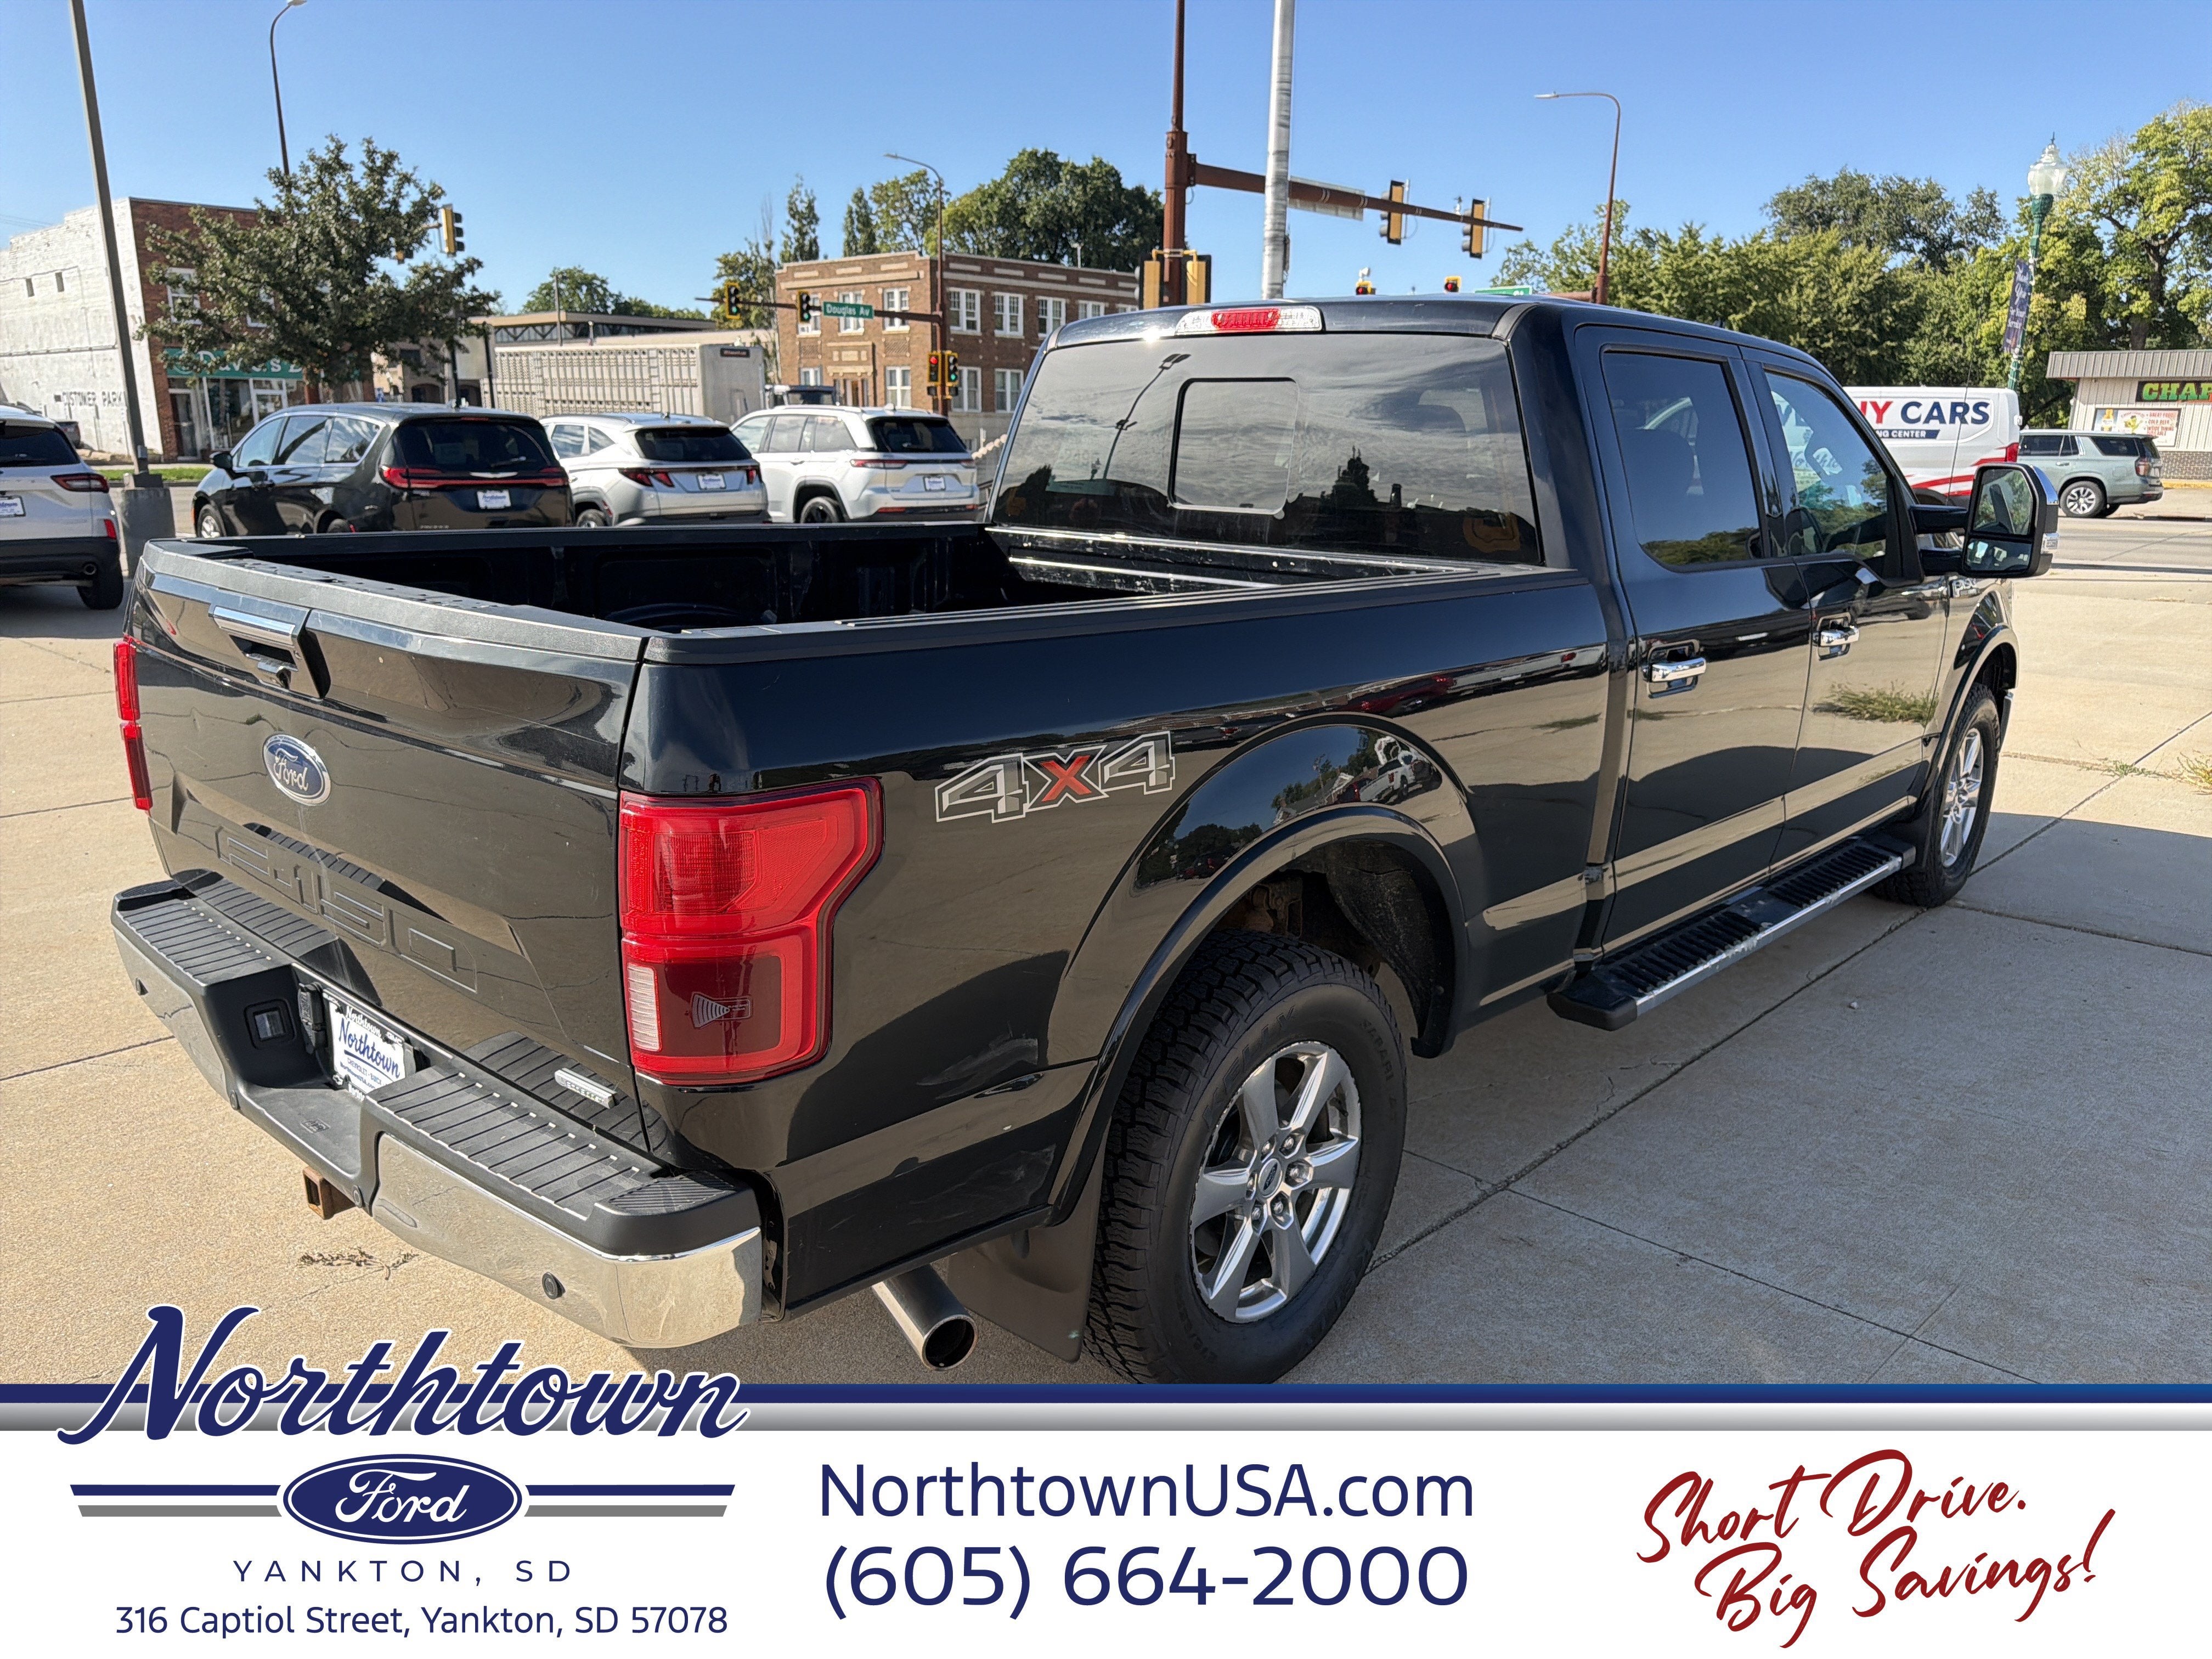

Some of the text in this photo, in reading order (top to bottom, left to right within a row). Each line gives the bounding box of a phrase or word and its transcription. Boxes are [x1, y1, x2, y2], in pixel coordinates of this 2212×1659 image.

[826, 303, 870, 316] Douglas Av
[1900, 401, 1990, 424] CARS
[1891, 430, 1926, 438] CENTER
[273, 747, 309, 792] Ford
[338, 1018, 400, 1079] Northtown
